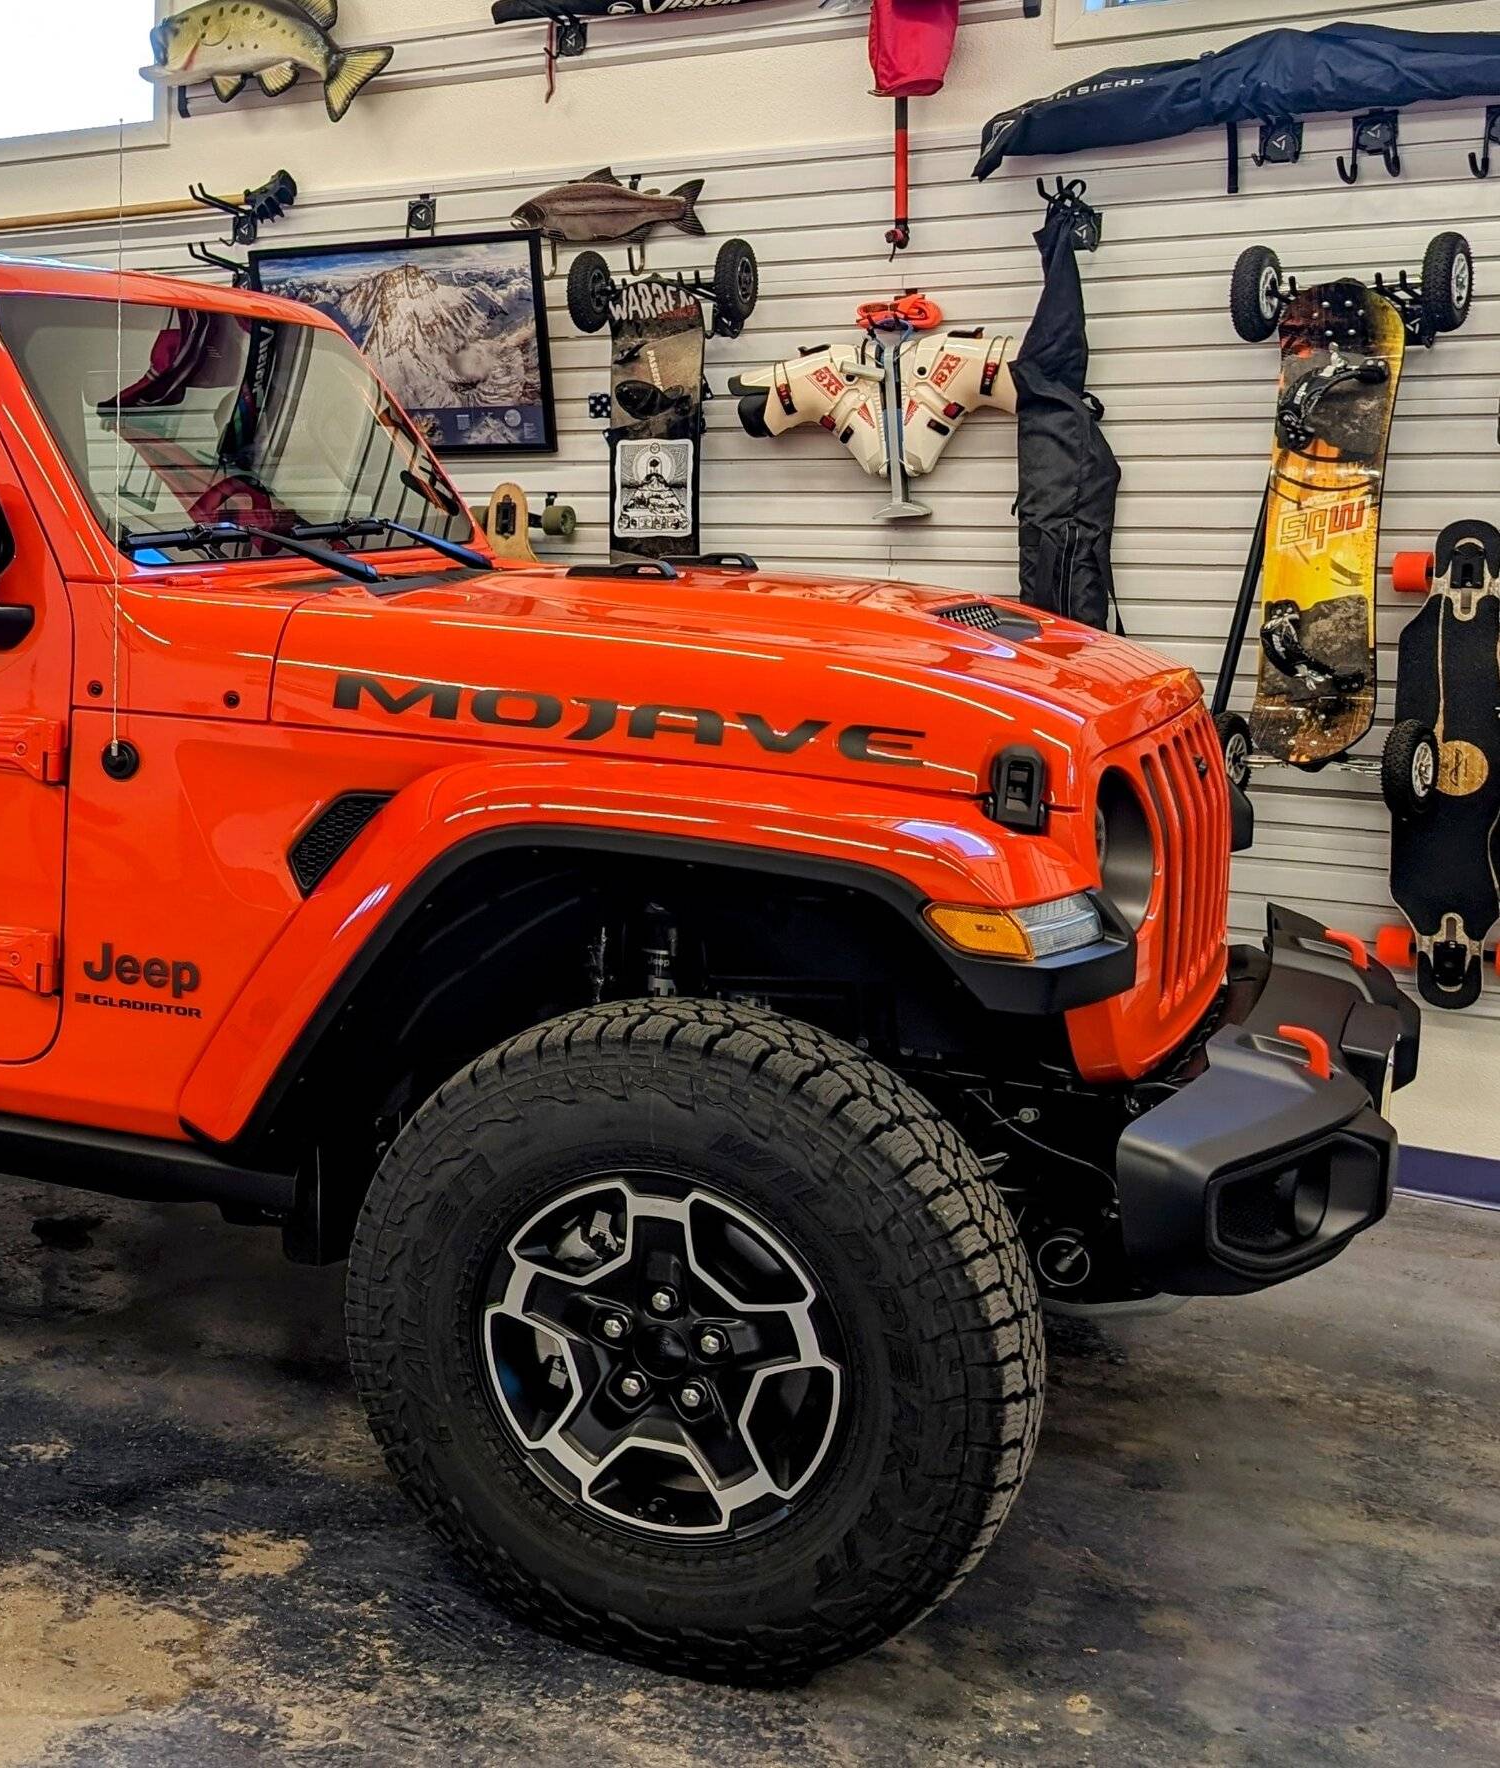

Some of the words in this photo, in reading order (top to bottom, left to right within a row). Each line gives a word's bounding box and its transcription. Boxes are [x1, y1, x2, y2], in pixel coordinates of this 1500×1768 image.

[332, 673, 927, 767] MOJAVE
[83, 942, 201, 999] Jeep
[93, 994, 202, 1019] GLADIATOR
